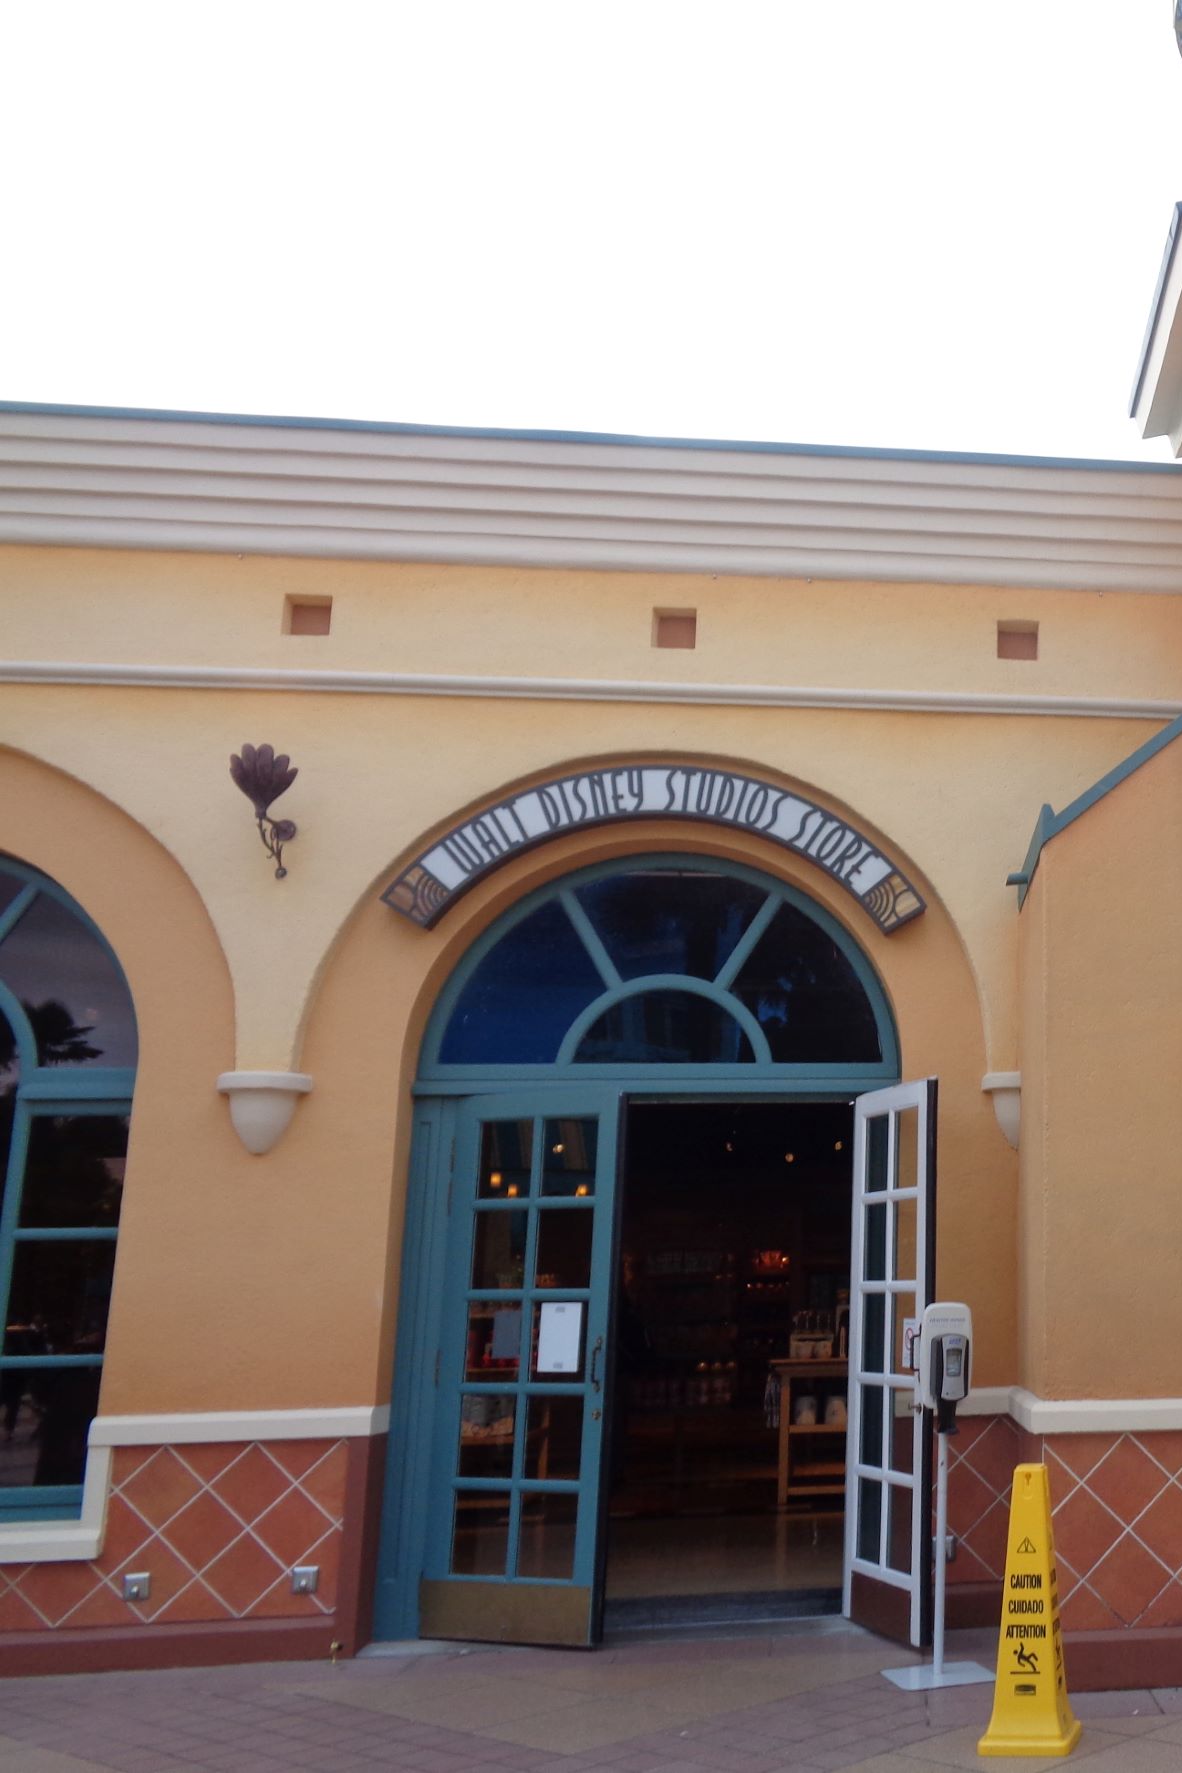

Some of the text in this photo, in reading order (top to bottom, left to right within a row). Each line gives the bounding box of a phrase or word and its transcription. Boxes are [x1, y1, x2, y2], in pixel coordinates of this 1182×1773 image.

[443, 769, 881, 883] WALT DISNEY STUDIOS STORE
[1010, 1574, 1042, 1589] CAUTION
[1008, 1599, 1044, 1614] CUIDADO
[1006, 1624, 1046, 1639] ATTENTION
